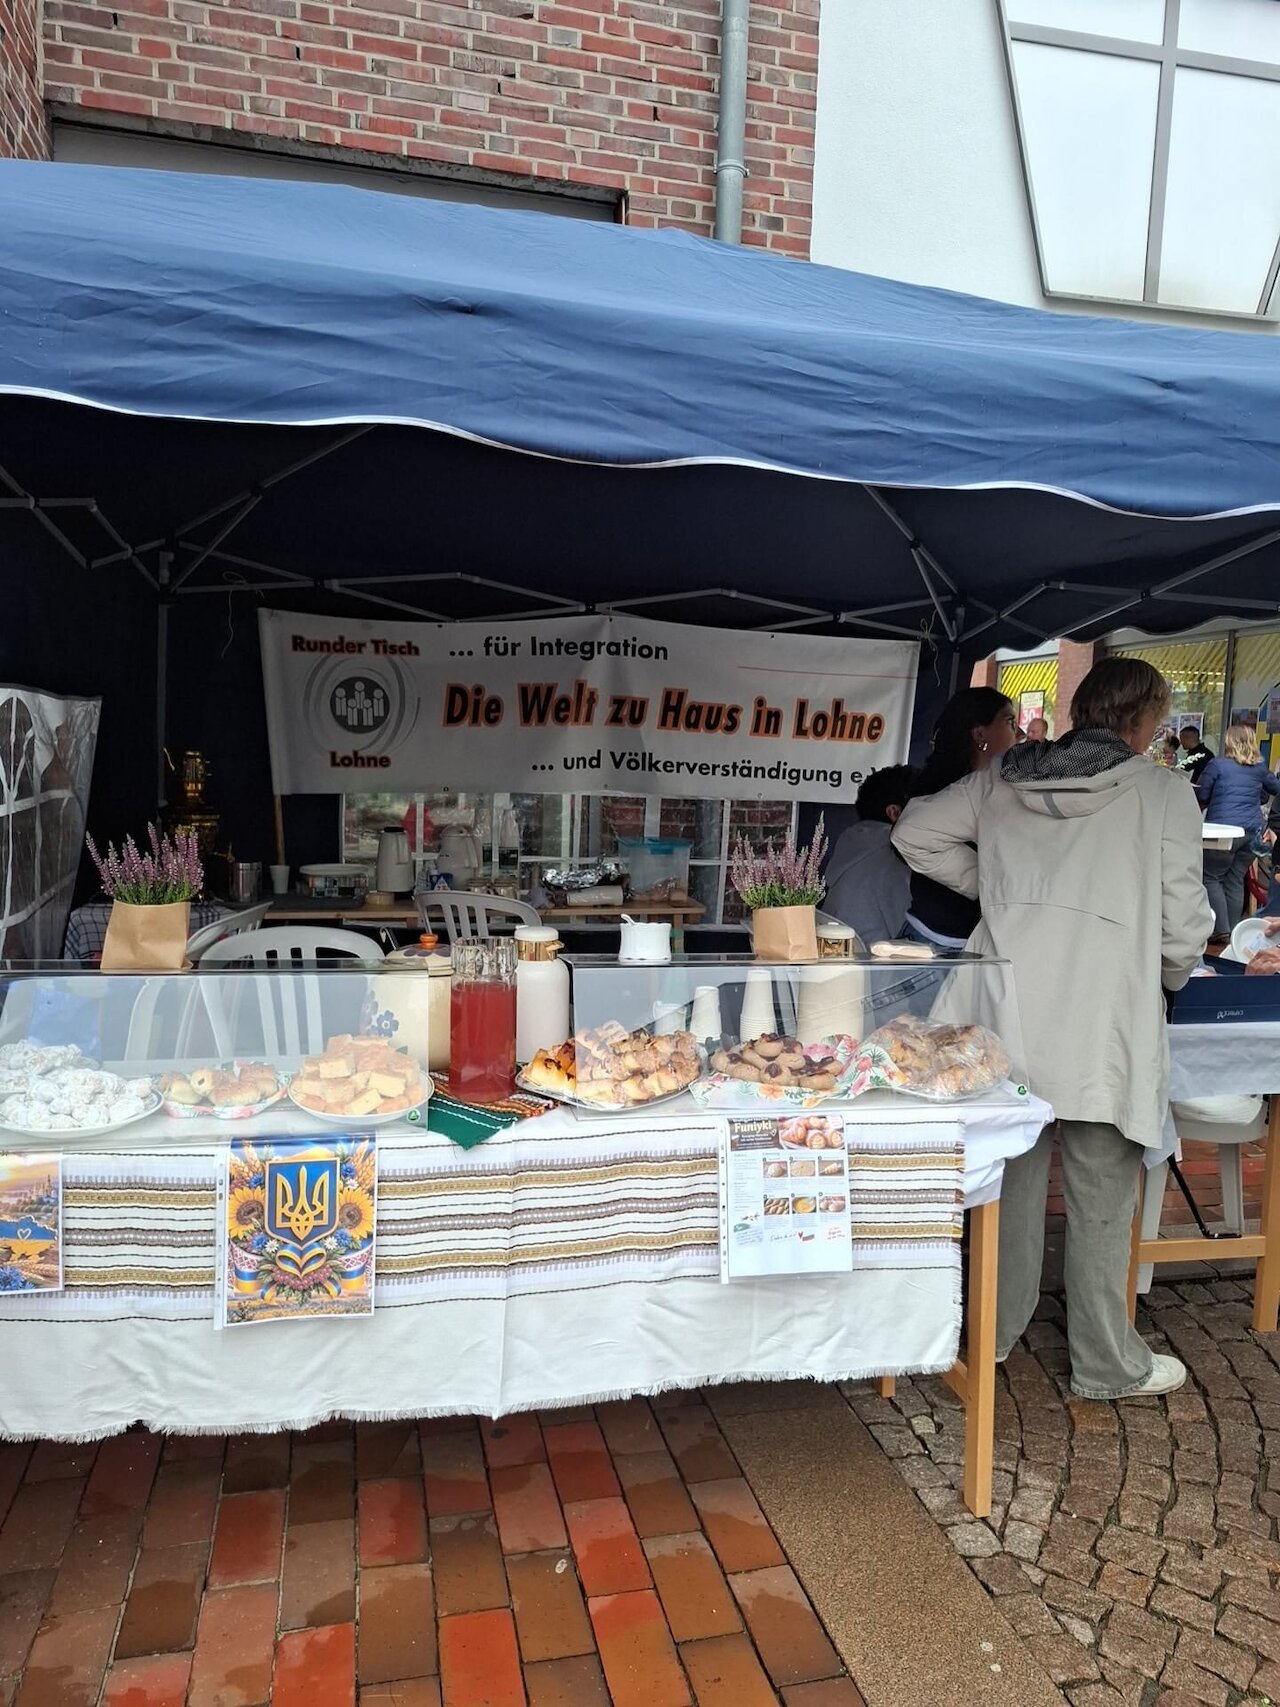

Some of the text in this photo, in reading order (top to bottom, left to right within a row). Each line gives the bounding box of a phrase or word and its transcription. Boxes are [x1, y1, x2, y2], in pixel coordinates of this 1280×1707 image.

[292, 635, 420, 656] Runder Tisch
[483, 636, 521, 657] für
[530, 636, 669, 661] Integration
[442, 679, 885, 743] Die Welt zu Haus in Lohne
[329, 751, 391, 769] Lohne
[562, 749, 602, 771] und
[609, 751, 842, 787] Völkerverständigung
